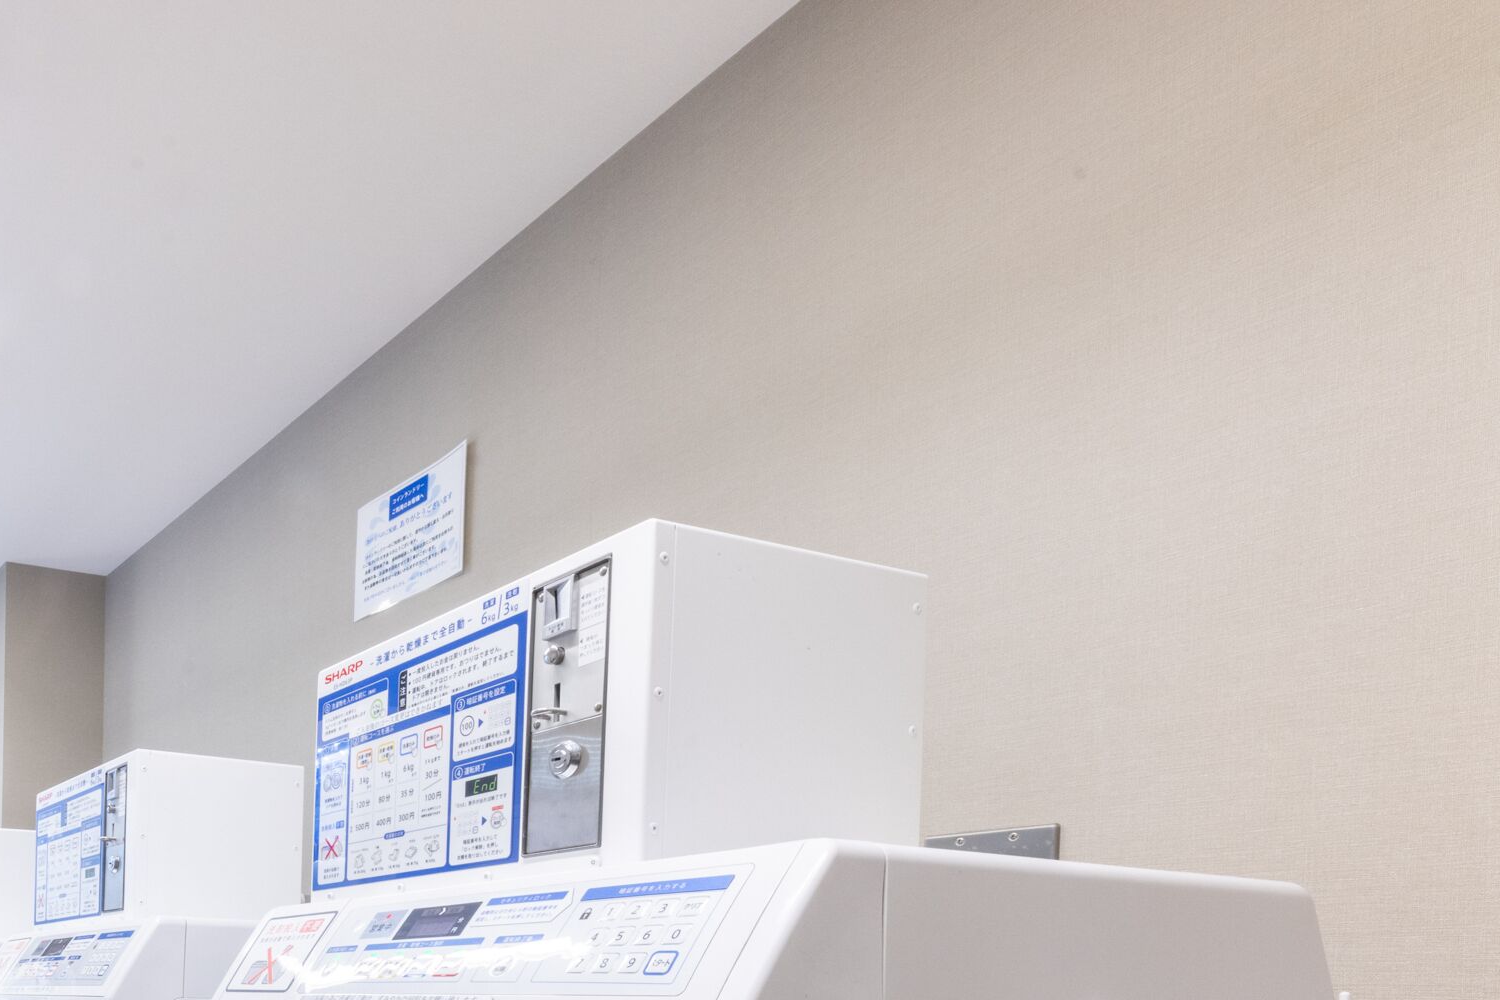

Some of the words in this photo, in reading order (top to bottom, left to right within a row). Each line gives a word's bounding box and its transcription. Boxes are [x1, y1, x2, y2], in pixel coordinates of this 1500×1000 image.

[481, 610, 495, 625] 6kg
[503, 601, 519, 616] 3kg
[375, 618, 465, 666] 洗濯から乾燥まで全自動
[324, 660, 363, 685] SHARP
[473, 776, 497, 794] End
[631, 905, 641, 915] 2
[659, 903, 669, 913] 3
[591, 932, 599, 941] 4
[615, 931, 625, 941] 5
[643, 930, 651, 940] 6
[671, 929, 682, 940] 0
[600, 958, 609, 968] 8
[627, 958, 637, 968] 9
